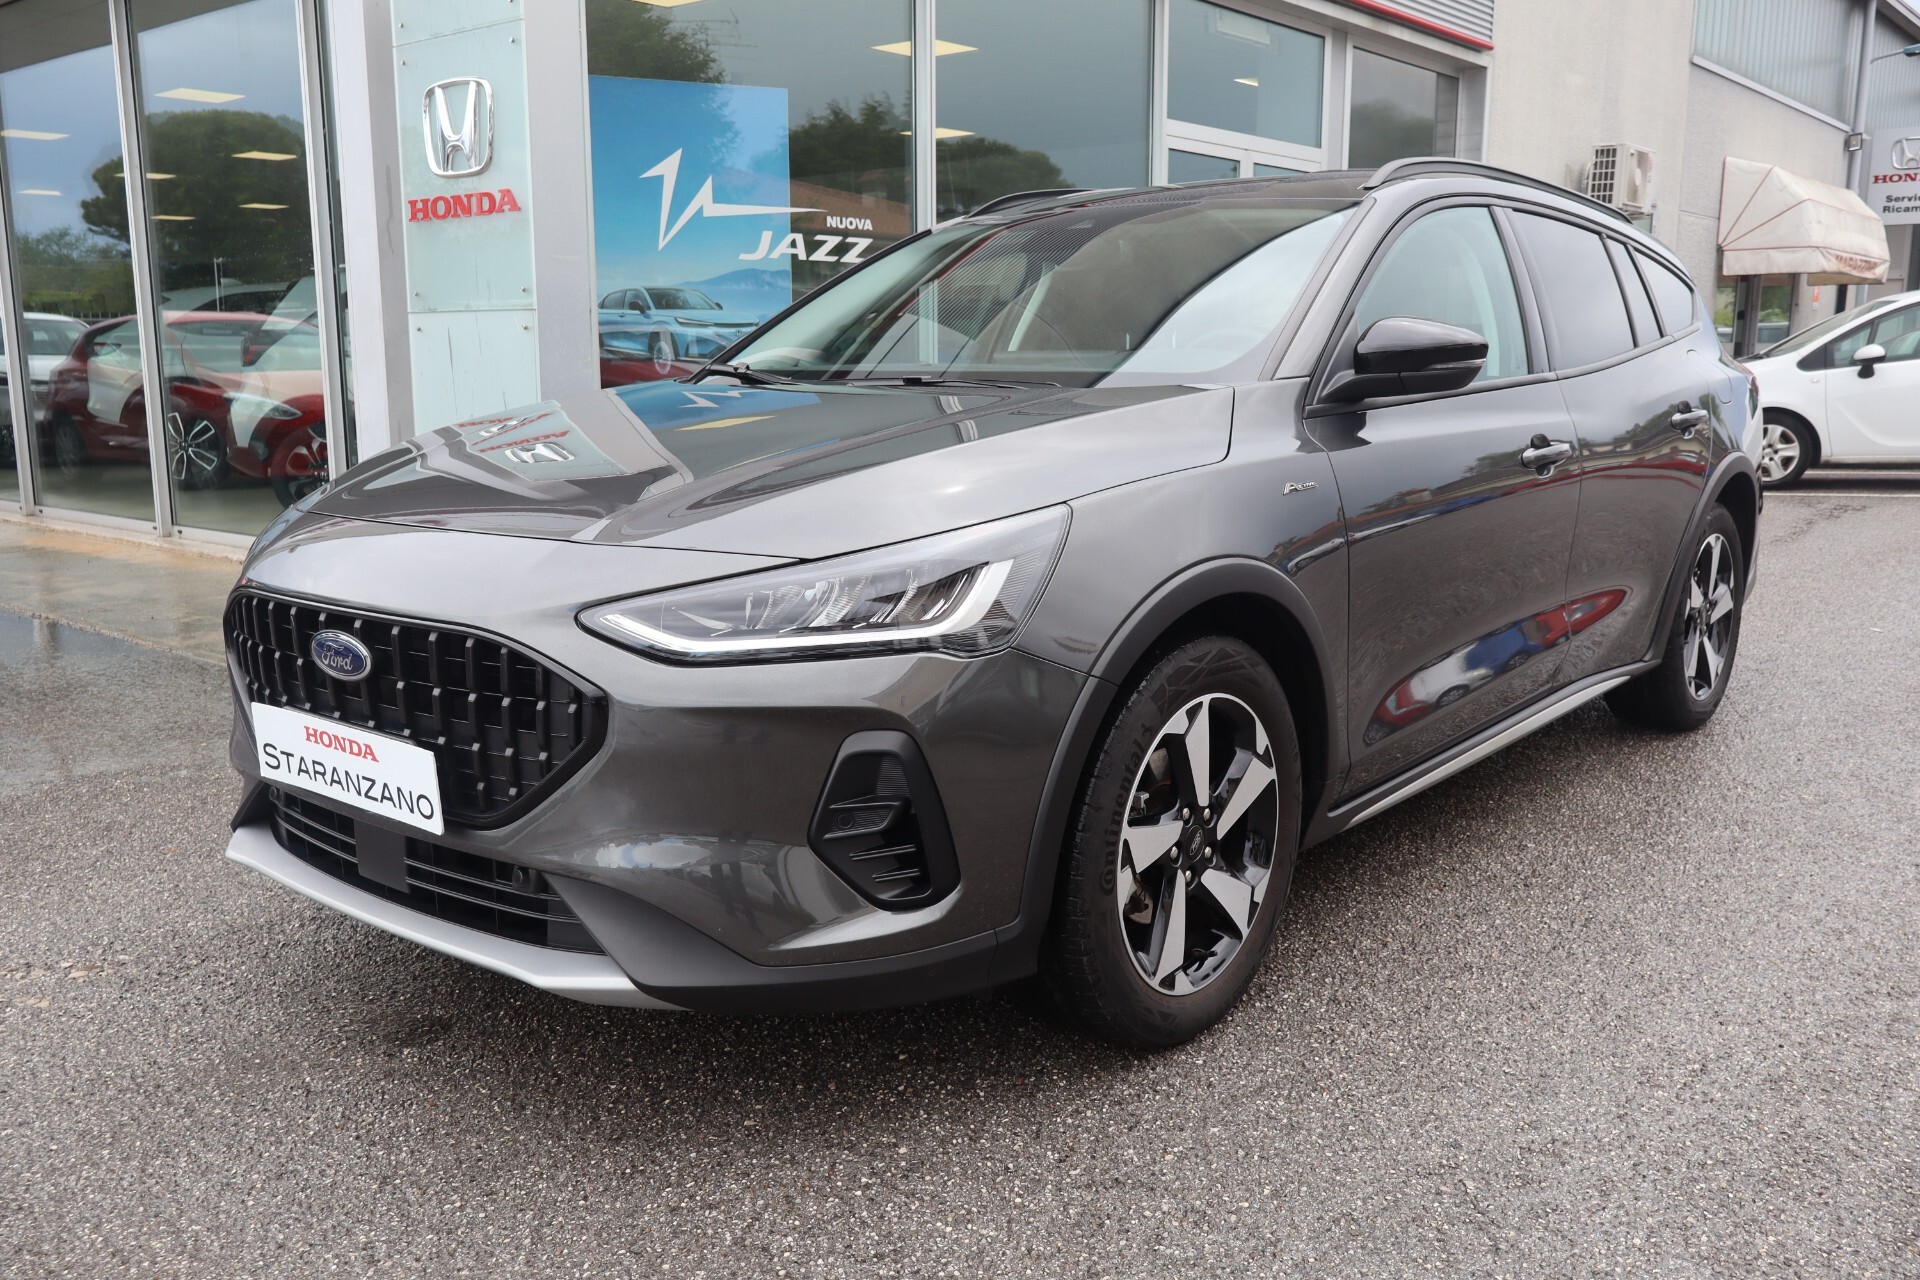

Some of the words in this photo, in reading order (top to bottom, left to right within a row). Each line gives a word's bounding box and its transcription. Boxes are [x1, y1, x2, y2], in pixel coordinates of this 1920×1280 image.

[1872, 172, 1920, 184] HON
[408, 188, 521, 222] HONDA
[826, 215, 873, 231] NUOVA
[738, 230, 874, 264] JAZZ
[321, 642, 354, 671] Ford
[304, 725, 380, 763] HONDA
[263, 743, 434, 820] STARANZANO
[1102, 737, 1145, 897] Continental
